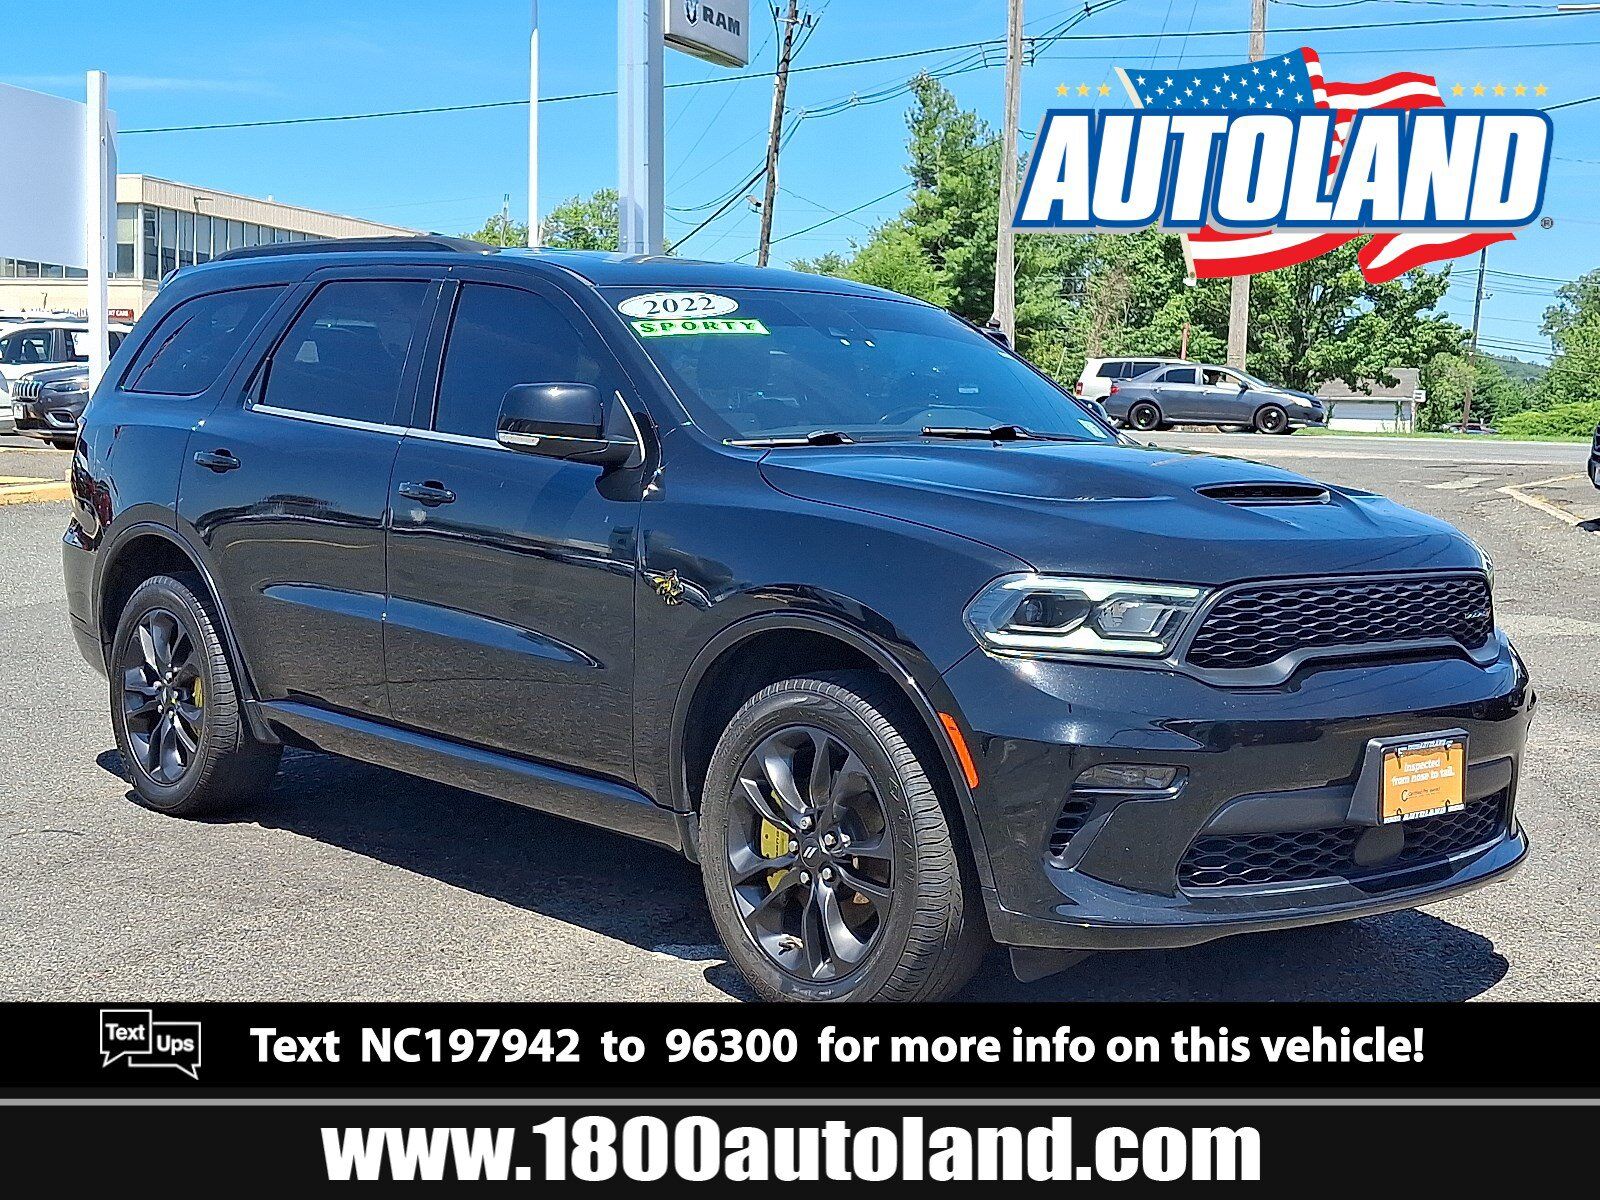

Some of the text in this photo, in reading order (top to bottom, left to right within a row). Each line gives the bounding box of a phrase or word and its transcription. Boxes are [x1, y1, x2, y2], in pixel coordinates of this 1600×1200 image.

[702, 5, 740, 36] RAM
[643, 296, 716, 315] 2022
[639, 321, 756, 333] SPORTY
[1404, 759, 1441, 773] Inspected
[1391, 775, 1410, 786] from
[1411, 773, 1430, 782] nose
[1430, 770, 1440, 779] to
